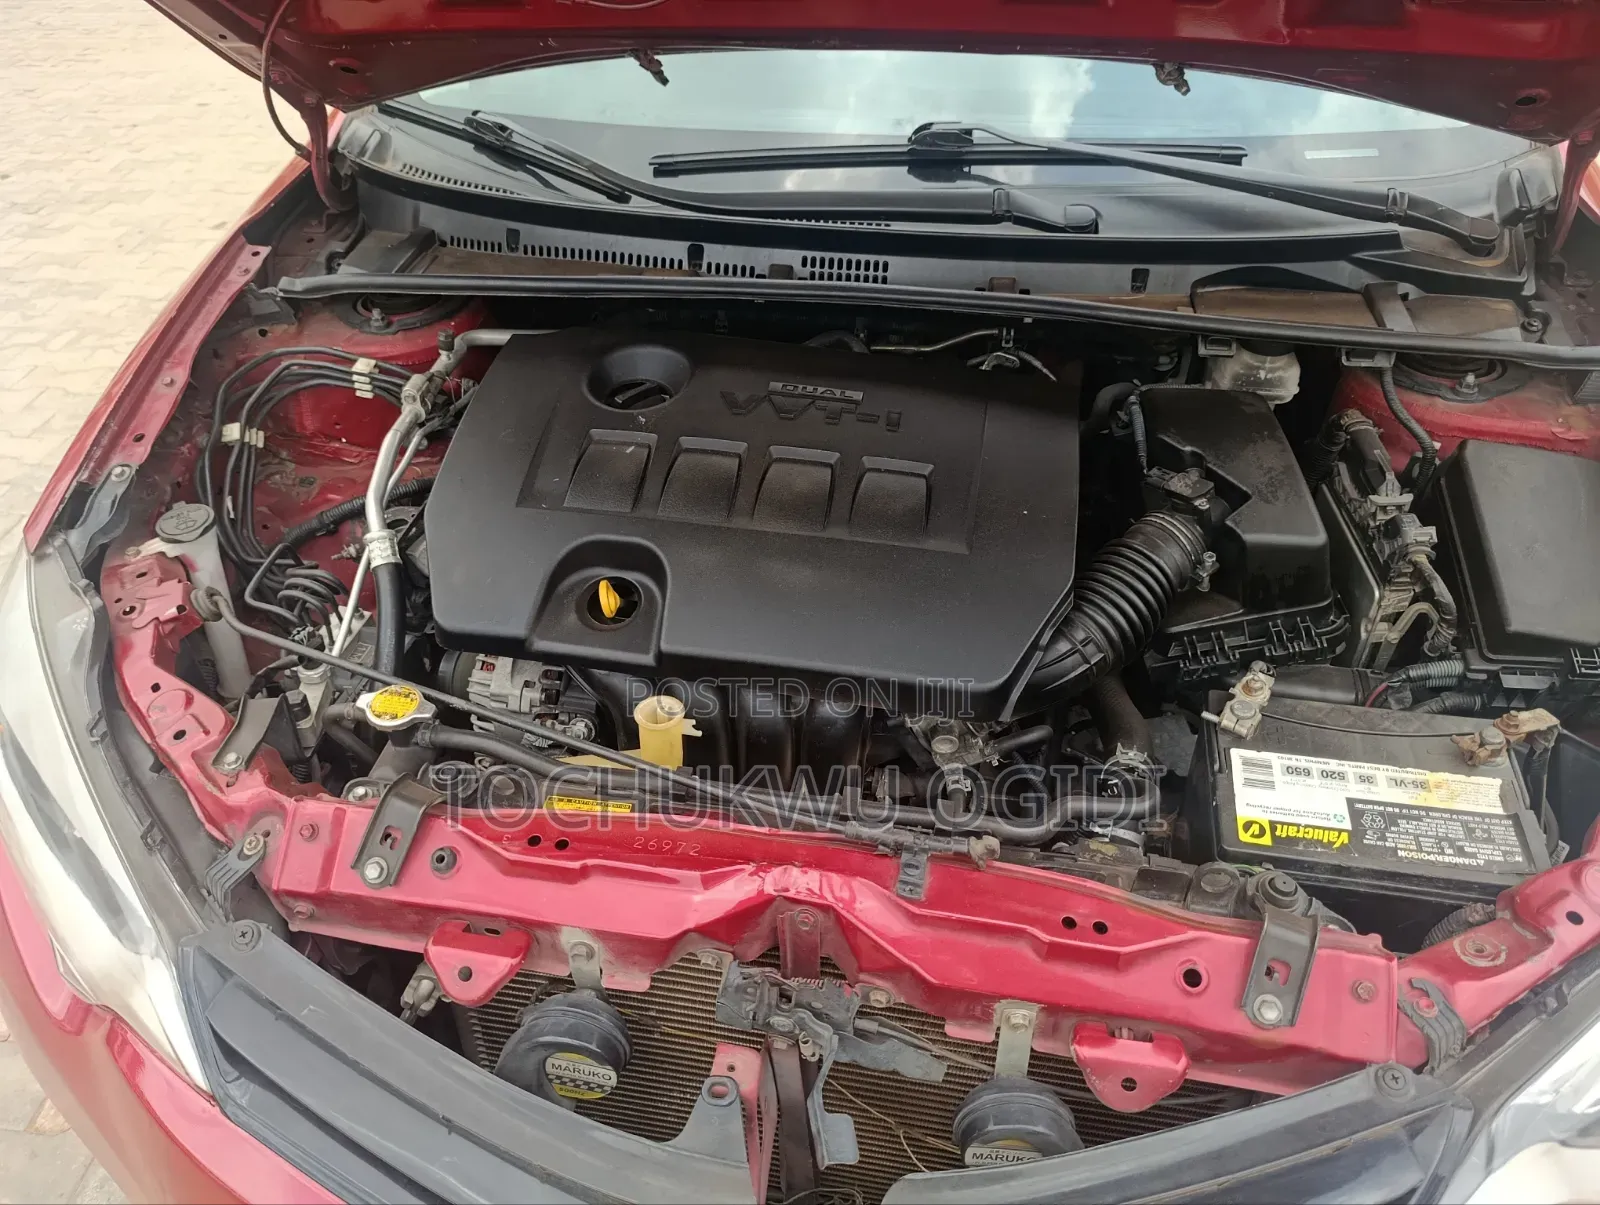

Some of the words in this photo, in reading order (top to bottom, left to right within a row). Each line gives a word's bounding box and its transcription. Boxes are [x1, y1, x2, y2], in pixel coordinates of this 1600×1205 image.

[780, 383, 854, 398] DUAL
[1286, 766, 1311, 776] 650
[1321, 769, 1345, 780] 520
[1358, 775, 1374, 784] 35
[1389, 778, 1427, 790] 35-VL
[1275, 824, 1349, 849] Valucraft
[633, 836, 701, 856] 26972
[551, 1062, 612, 1081] MARUKO
